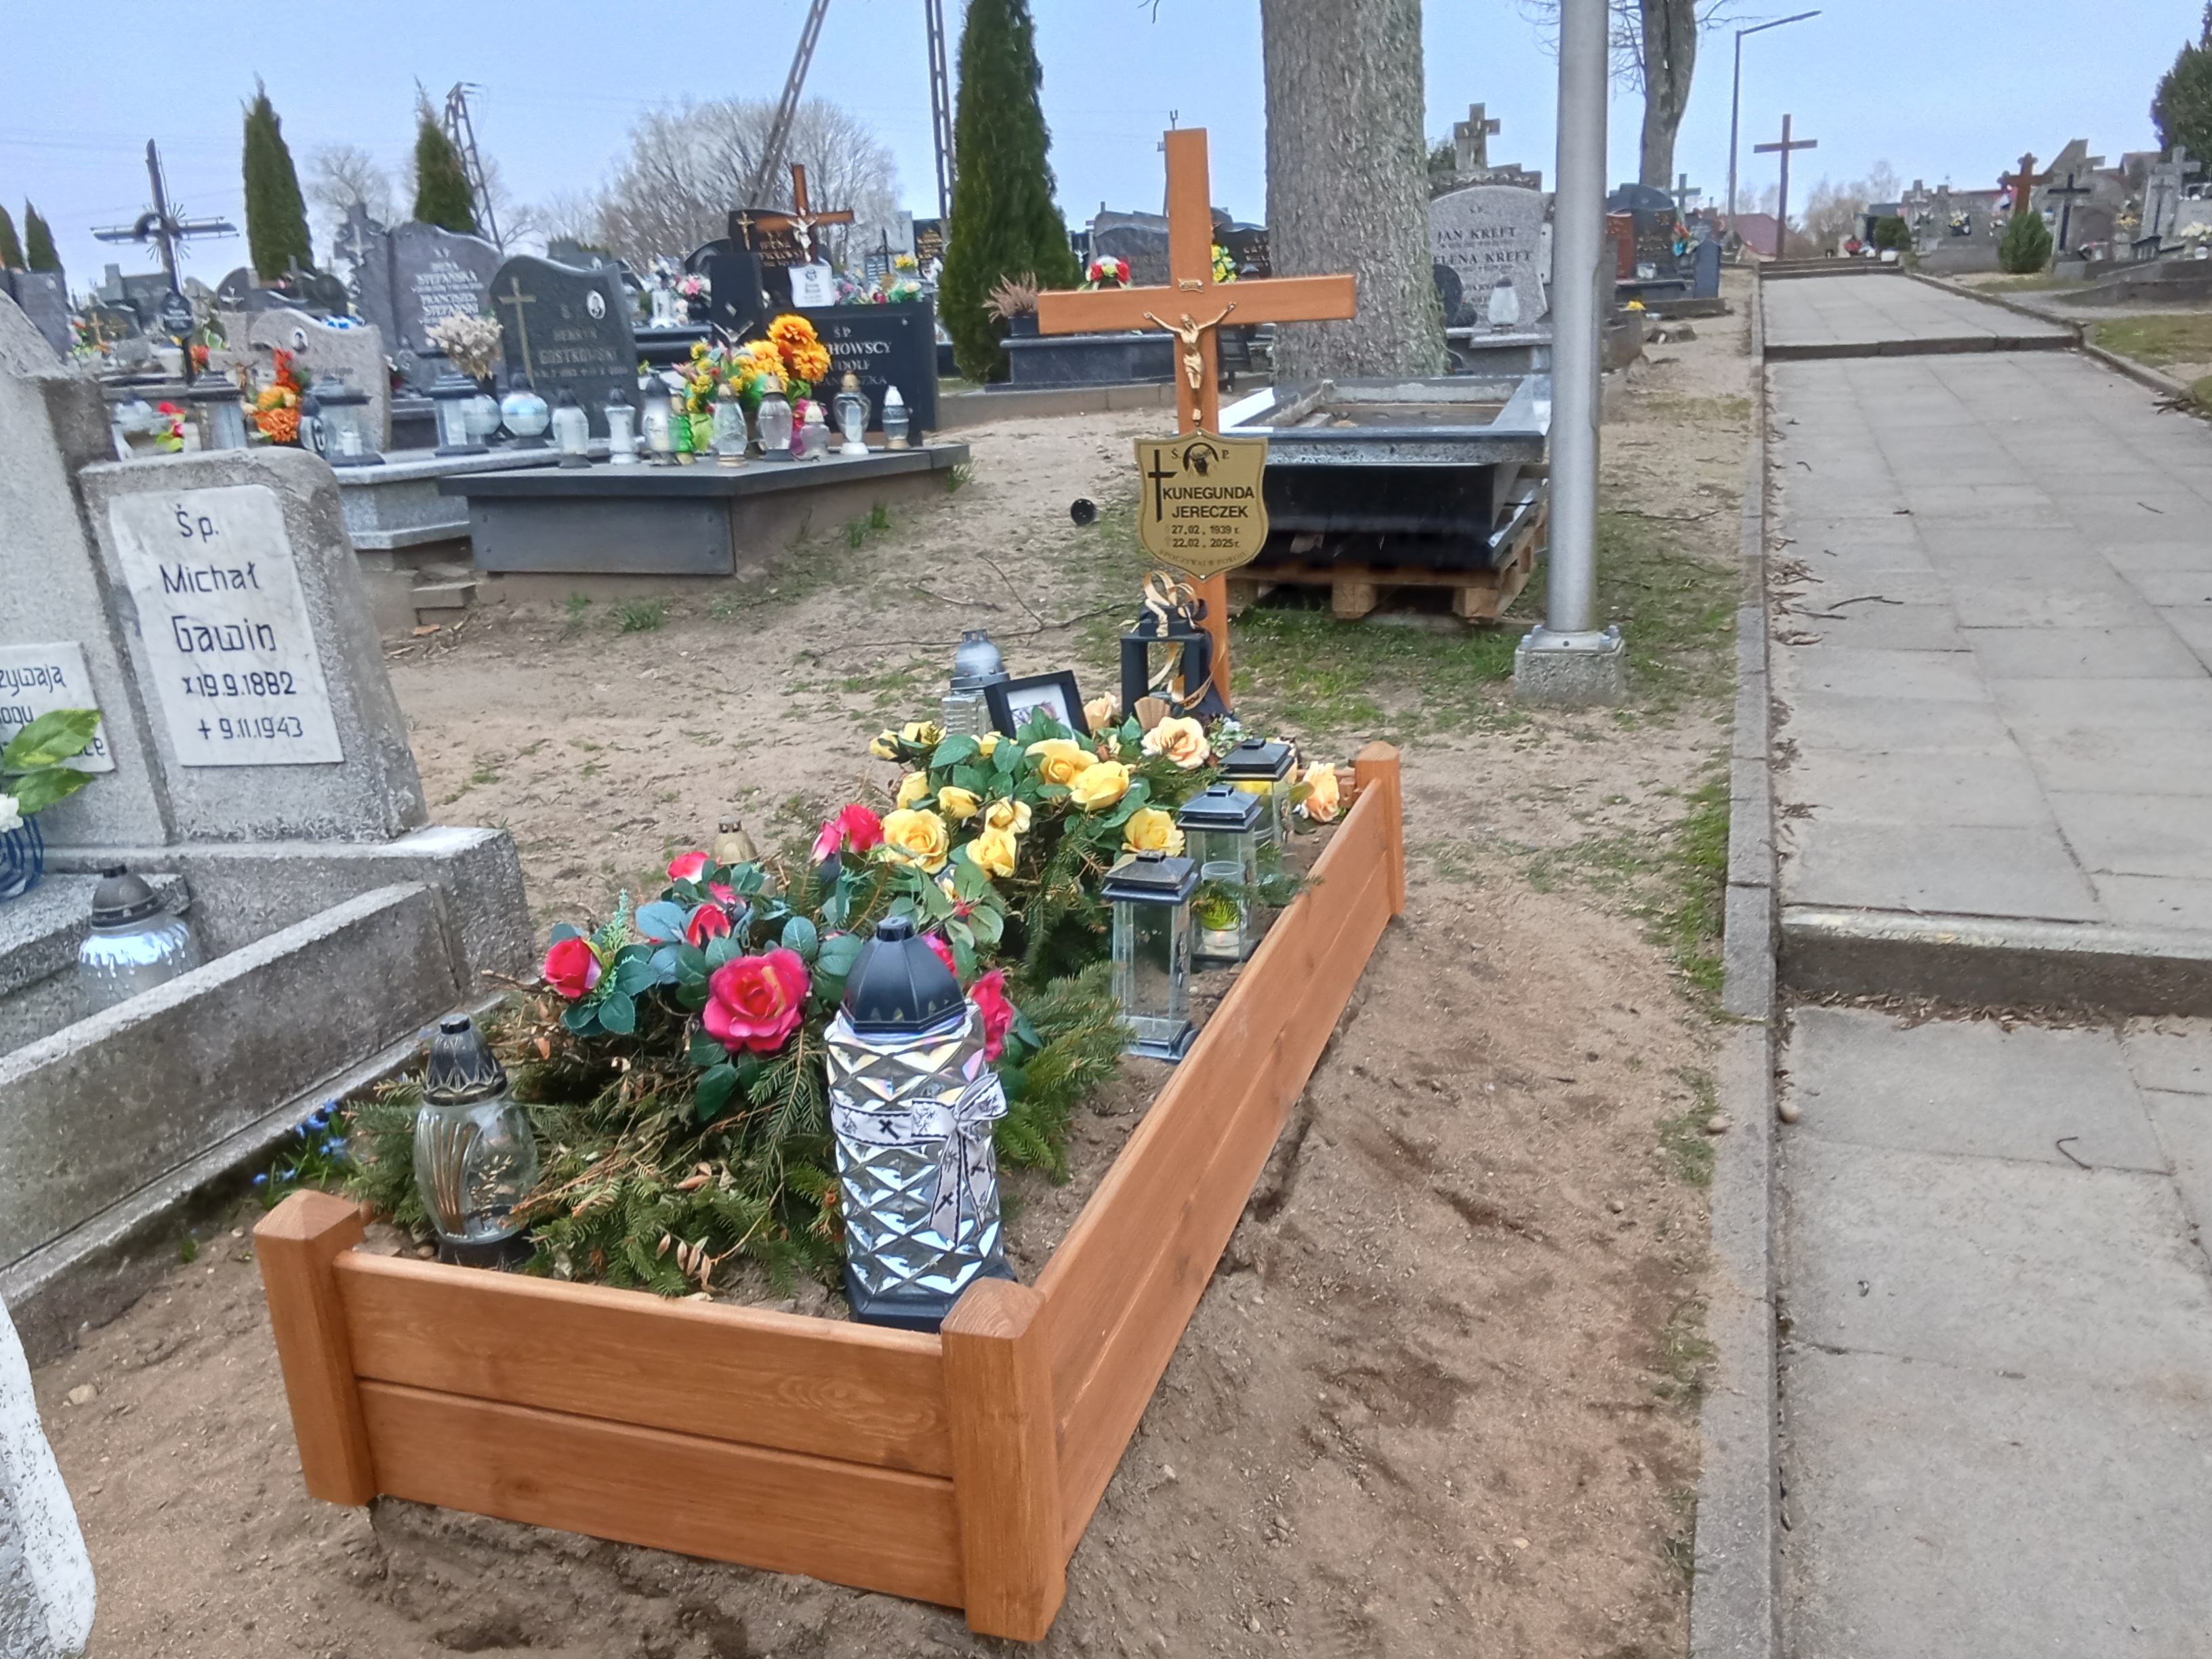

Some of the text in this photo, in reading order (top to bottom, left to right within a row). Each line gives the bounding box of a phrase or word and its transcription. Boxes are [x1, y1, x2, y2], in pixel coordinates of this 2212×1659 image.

[827, 342, 892, 355] HOWSCY
[1163, 487, 1254, 500] KUNEGUNDA
[1172, 506, 1248, 518] JERECZEK
[159, 561, 260, 594] Michał
[171, 615, 276, 653] Gawin
